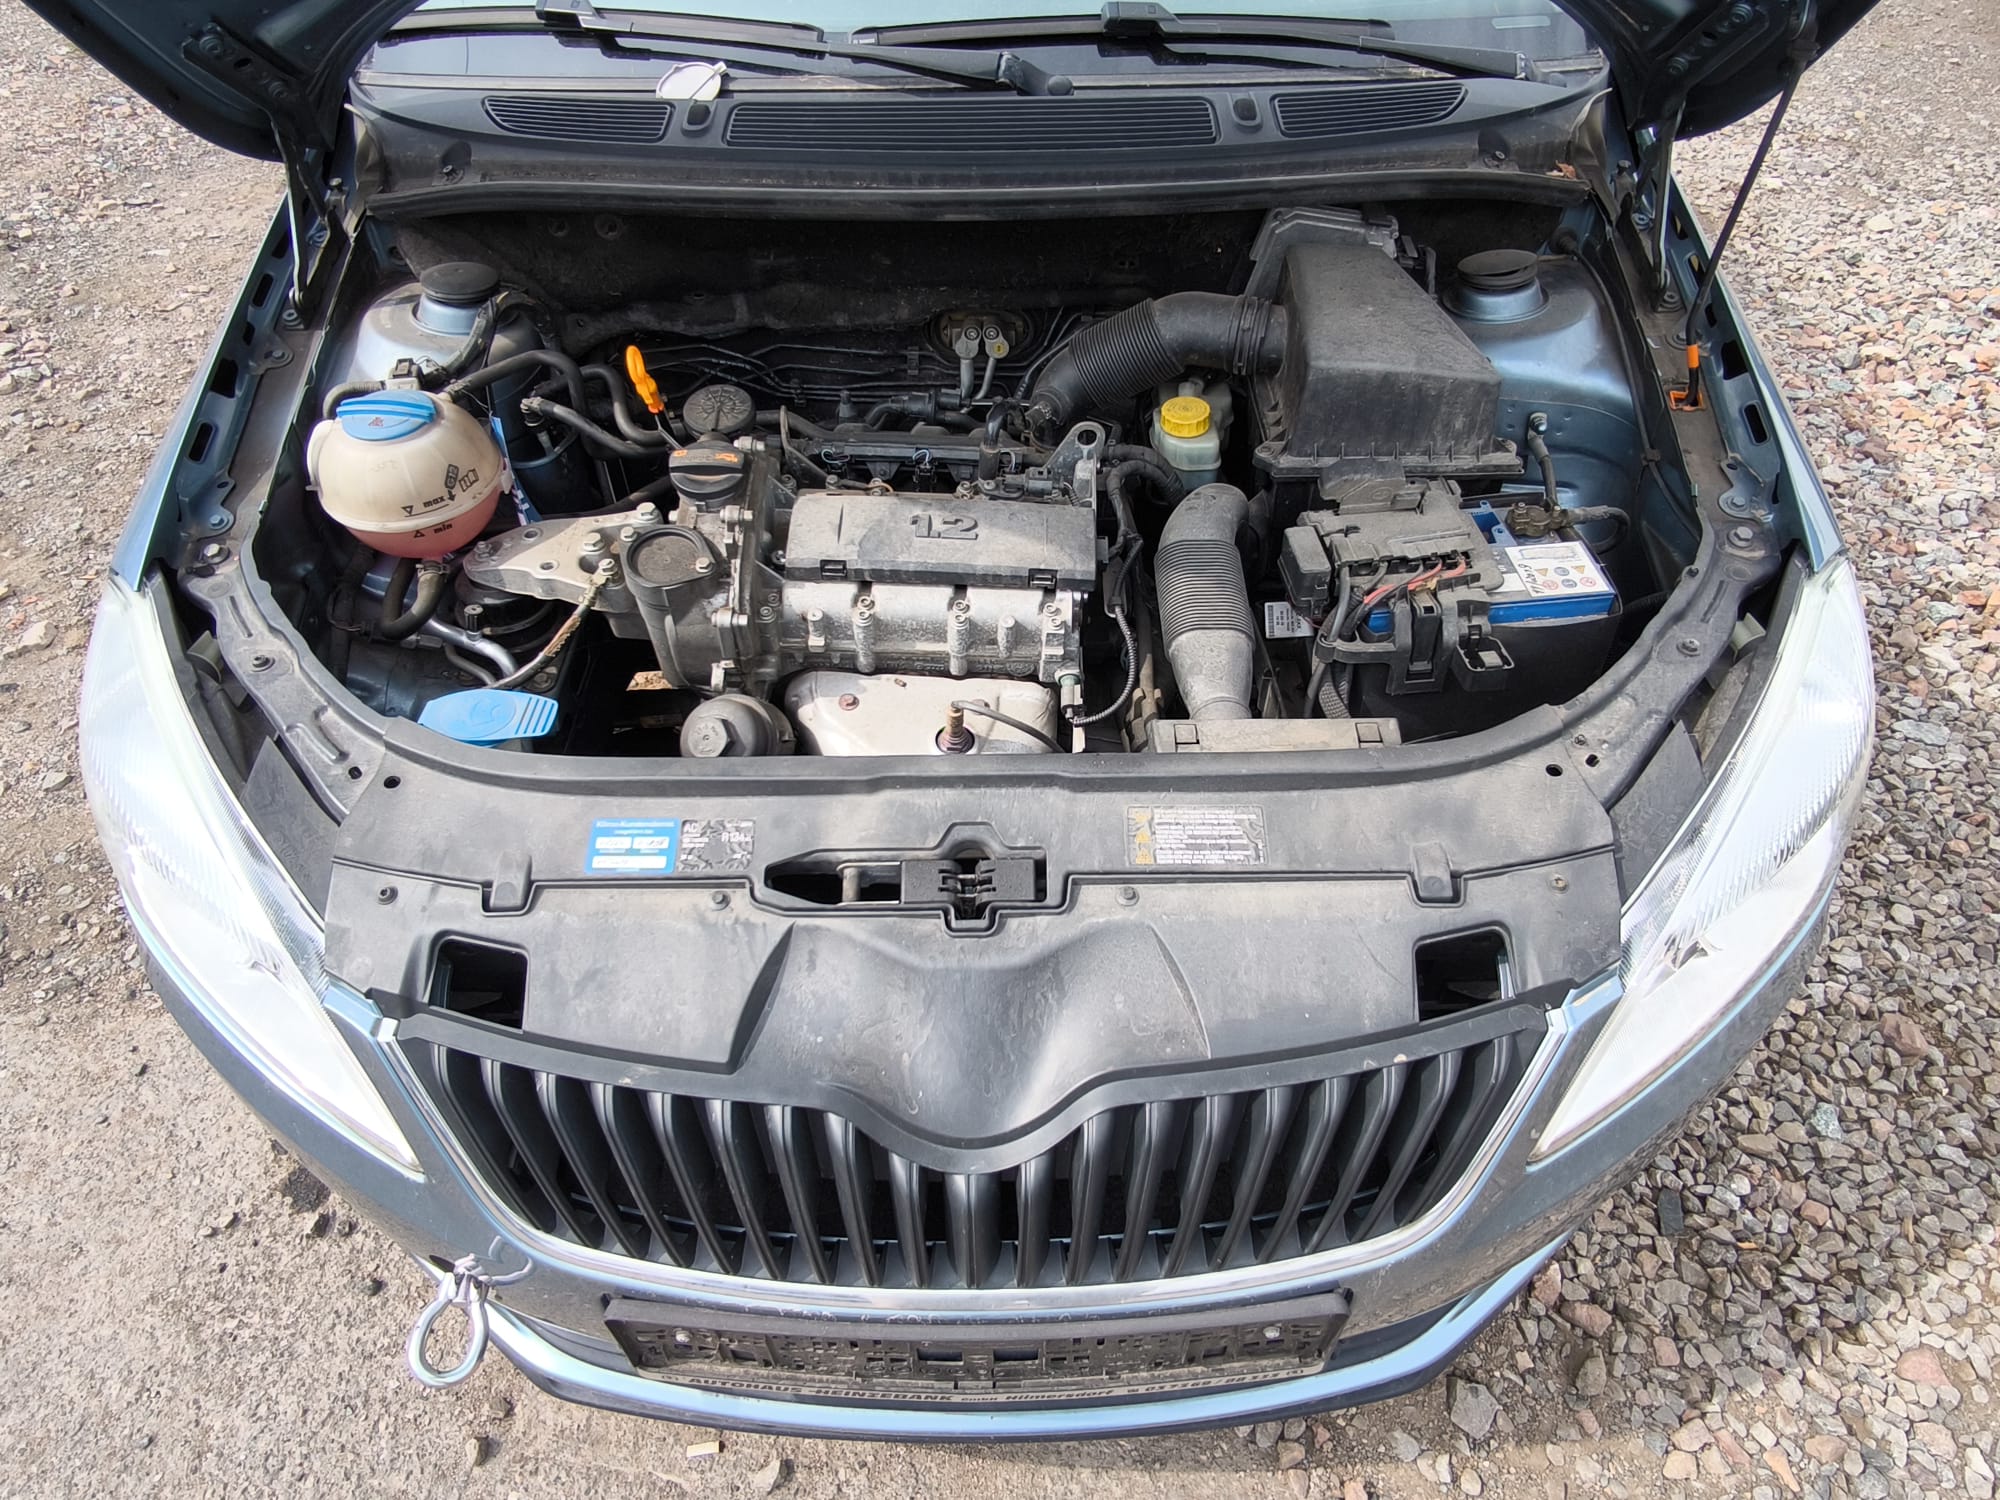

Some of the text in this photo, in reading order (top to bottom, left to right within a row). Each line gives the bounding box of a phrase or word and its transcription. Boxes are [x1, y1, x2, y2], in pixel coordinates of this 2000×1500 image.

[422, 495, 447, 508] max
[433, 523, 453, 534] min
[910, 512, 979, 541] 1.2
[683, 822, 698, 832] AC
[688, 1378, 803, 1393] AUTOHAUS
